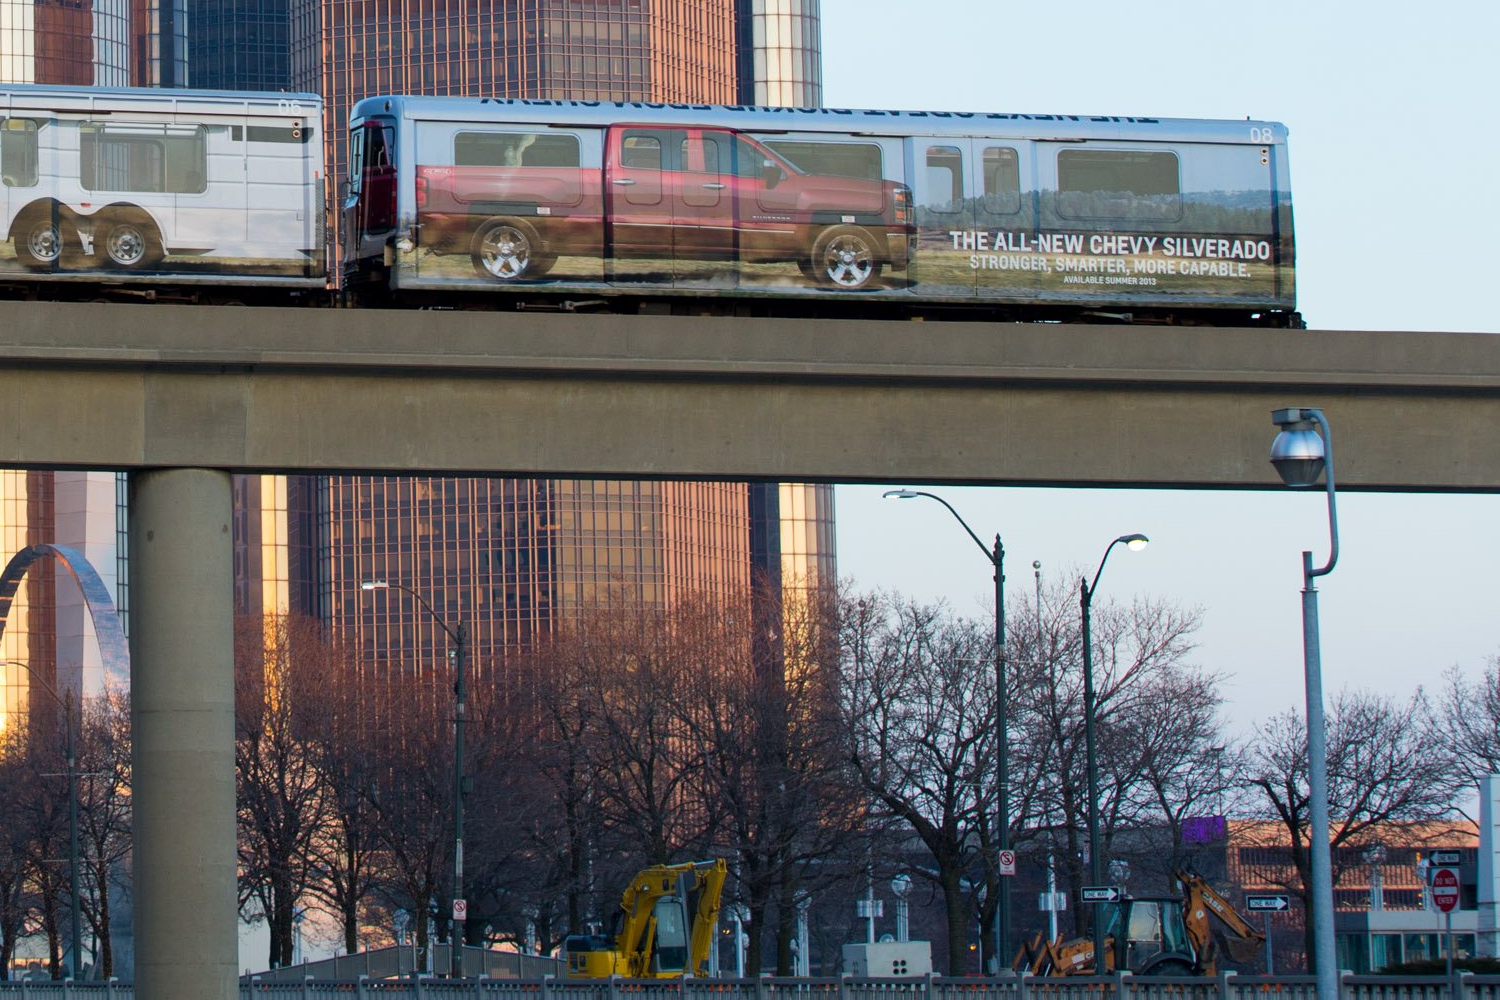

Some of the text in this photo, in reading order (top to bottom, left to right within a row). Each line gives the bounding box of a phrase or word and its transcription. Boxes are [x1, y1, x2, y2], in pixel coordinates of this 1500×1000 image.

[279, 99, 302, 116] 06
[1250, 127, 1274, 145] 08
[949, 230, 1270, 260] THE ALL-NEW CHEVY SILVERADO
[970, 254, 1252, 278] STRONGER, SMARTER, MORE CAPABLE.
[1063, 275, 1157, 287] AVAILABLE SUMMER 2013
